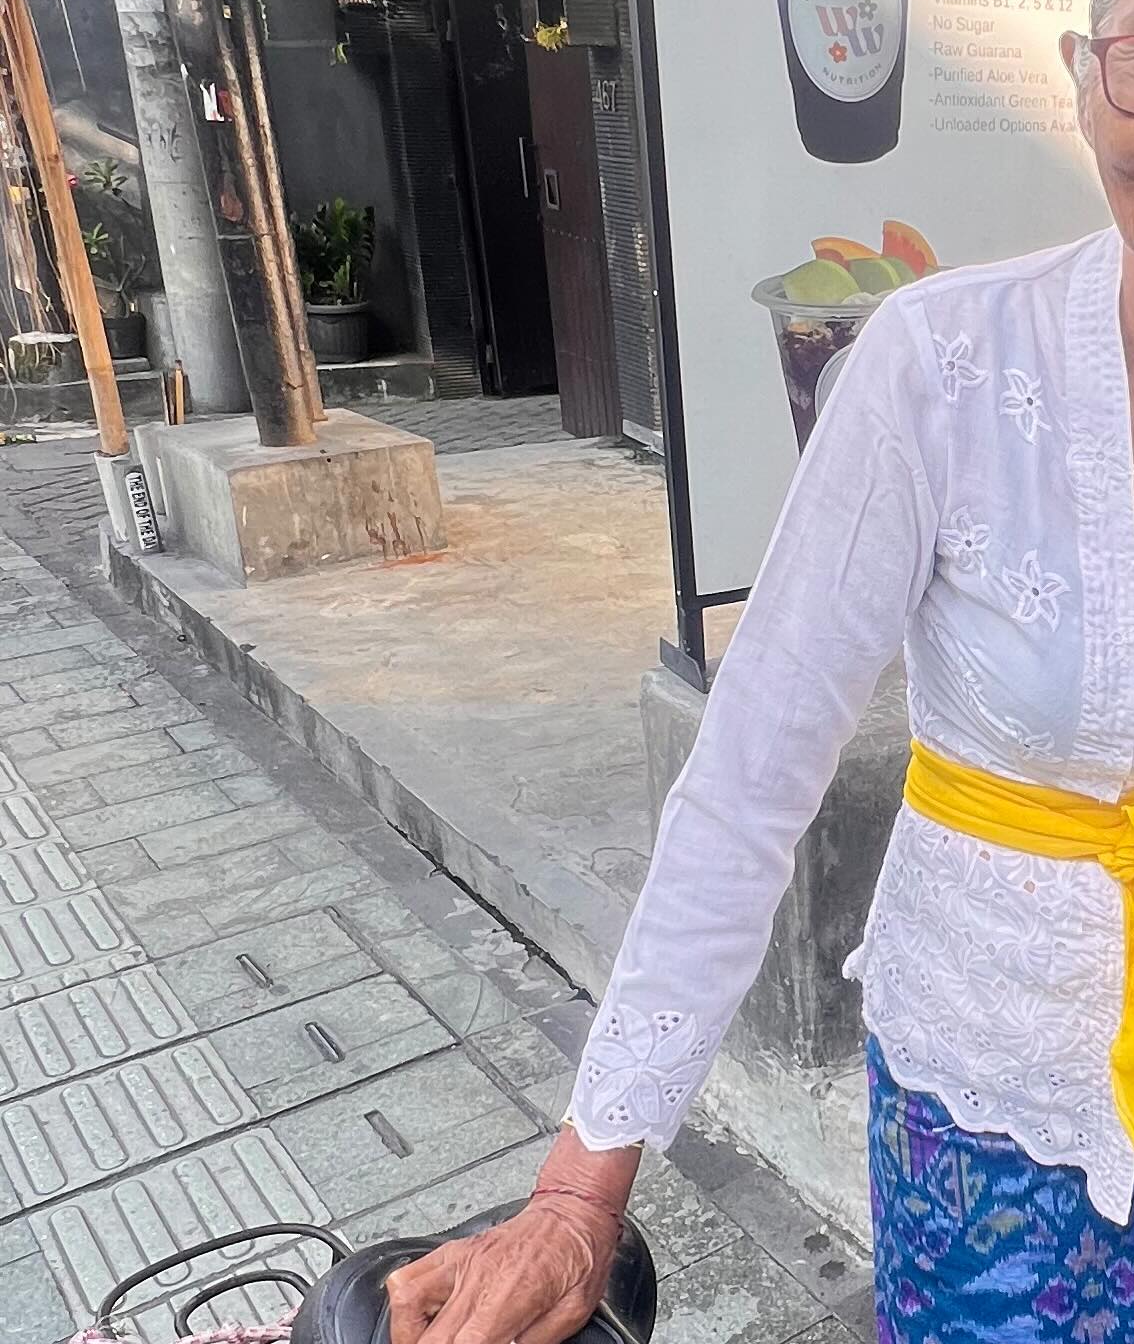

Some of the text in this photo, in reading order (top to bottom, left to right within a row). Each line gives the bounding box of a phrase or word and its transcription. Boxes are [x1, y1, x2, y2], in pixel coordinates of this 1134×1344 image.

[956, 16, 996, 35] Sugar
[966, 42, 1023, 59] Guarana
[822, 63, 882, 85] NUTRITION
[987, 68, 1016, 83] Aloe
[1018, 69, 1049, 85] Vera
[591, 79, 616, 113] 467
[1008, 93, 1047, 109] Green
[999, 117, 1047, 135] Options
[135, 508, 151, 518] OF
